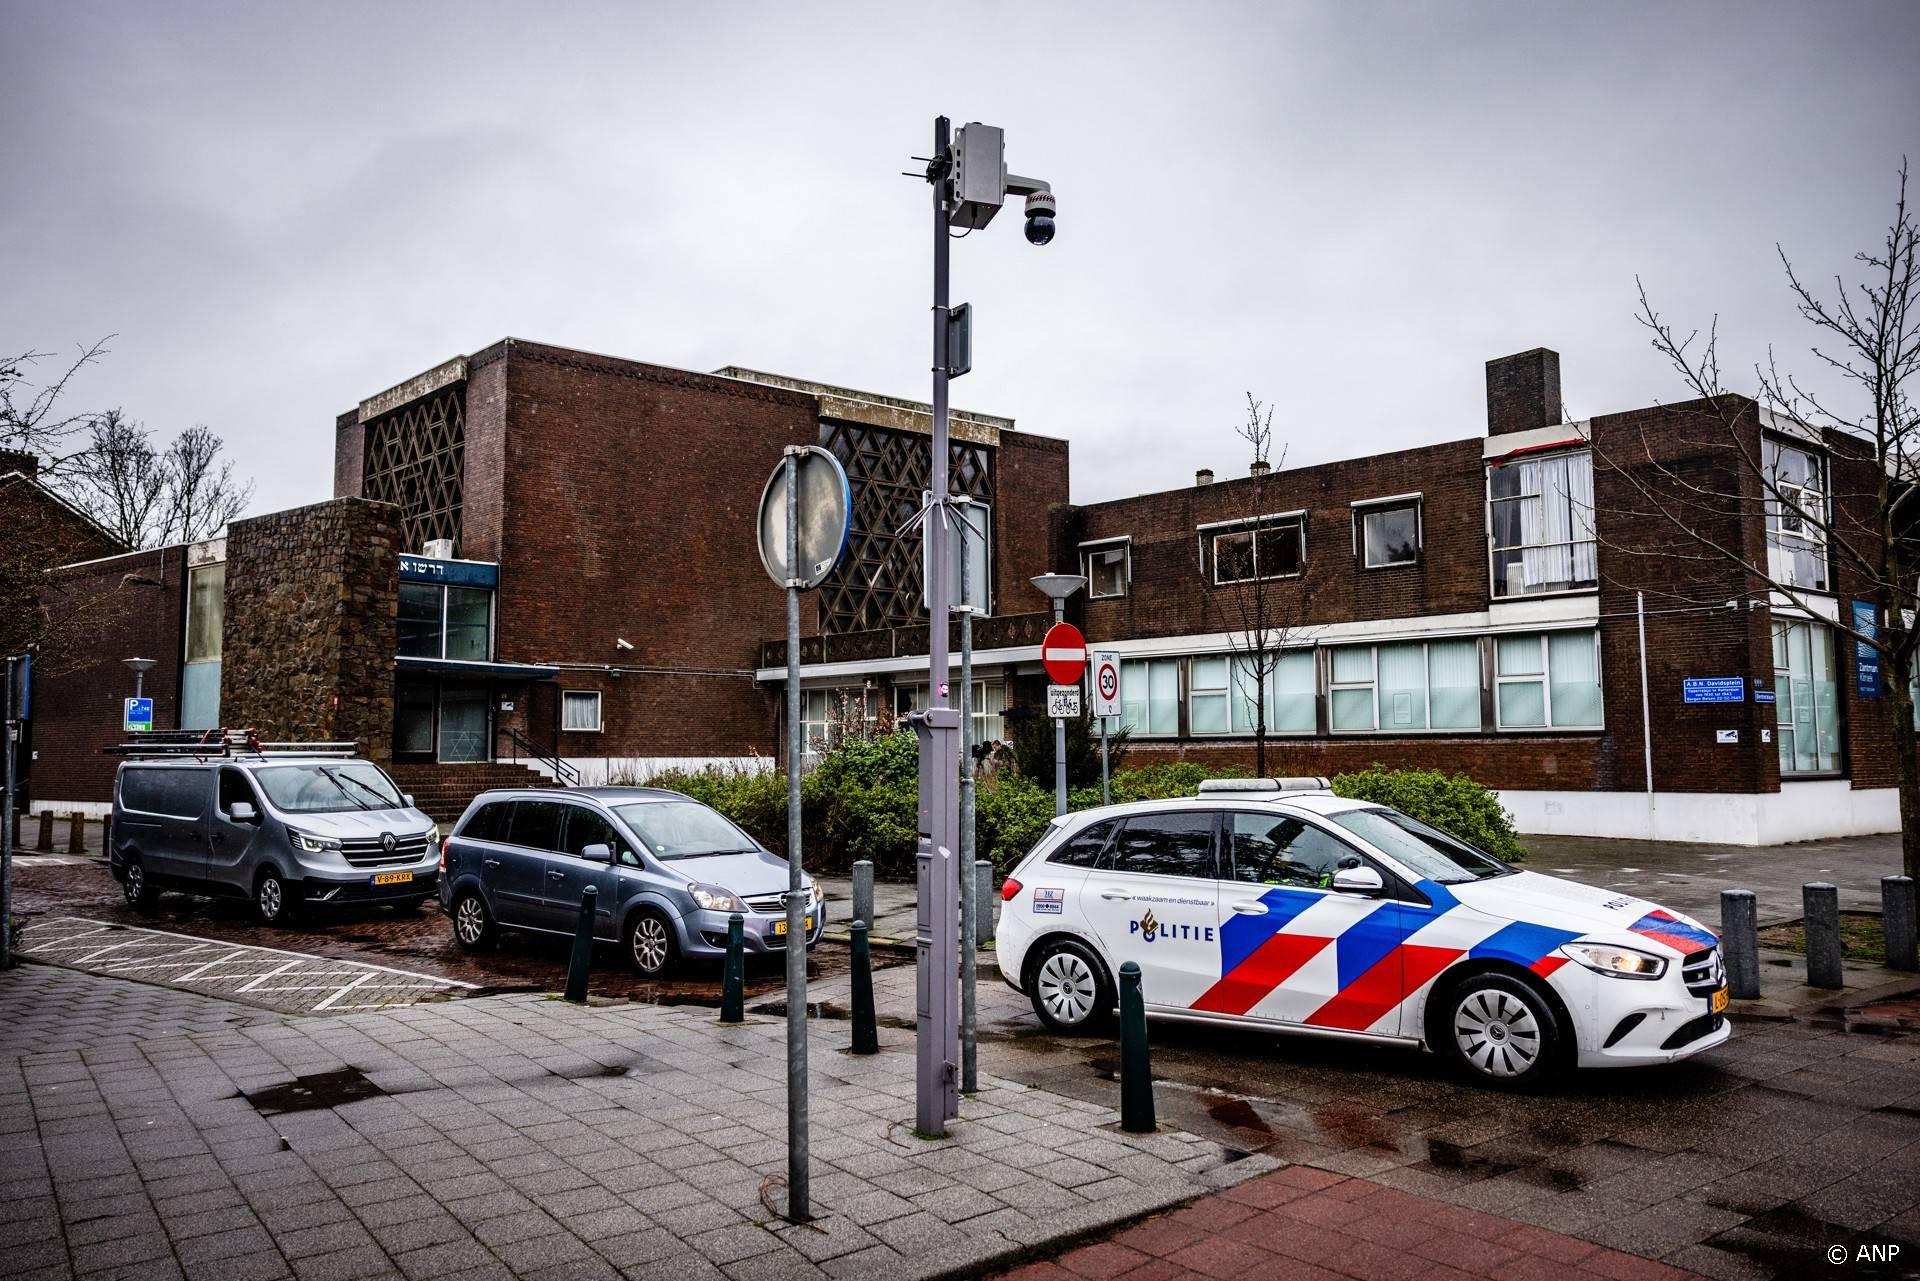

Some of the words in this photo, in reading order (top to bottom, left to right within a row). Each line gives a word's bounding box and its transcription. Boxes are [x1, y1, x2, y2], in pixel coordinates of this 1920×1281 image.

[398, 561, 409, 571] א
[413, 562, 444, 575] דרשו
[1102, 675, 1114, 689] 30
[1050, 689, 1080, 698] uitgezonderd
[130, 699, 139, 711] P
[377, 873, 411, 883] V-89-KRK
[1177, 897, 1210, 906] dienstbaar
[1130, 920, 1214, 942] POLITIE
